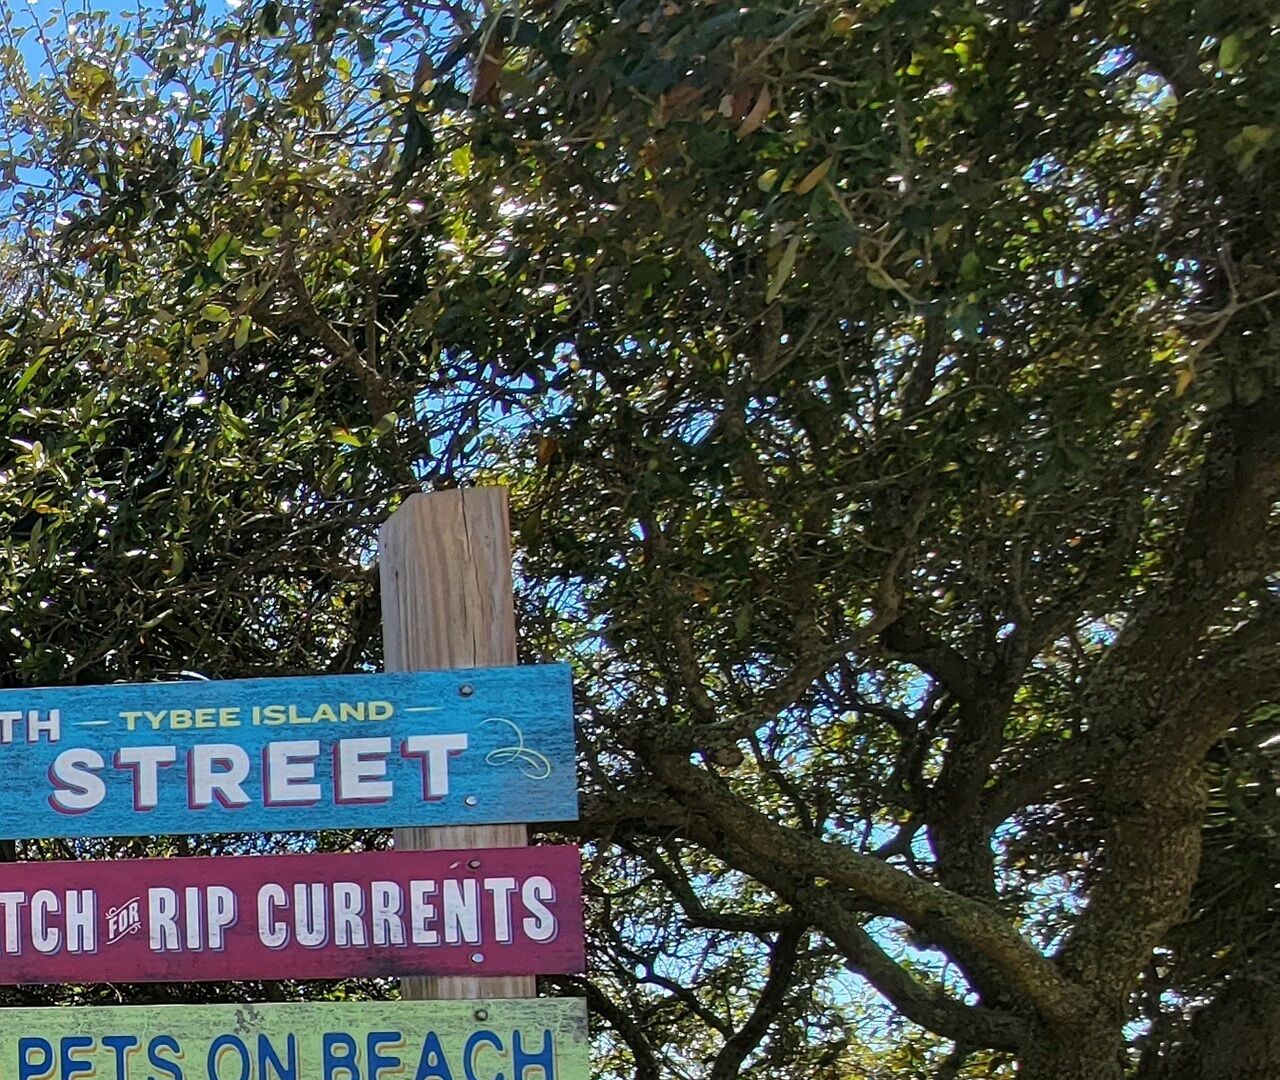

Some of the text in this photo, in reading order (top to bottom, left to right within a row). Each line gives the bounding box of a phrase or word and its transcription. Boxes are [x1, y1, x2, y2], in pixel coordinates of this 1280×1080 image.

[119, 700, 395, 731] TYBEE ISLAND
[50, 733, 469, 813] STREET
[107, 902, 141, 940] FOR
[149, 886, 238, 953] RIP
[258, 875, 559, 949] CURRENTS
